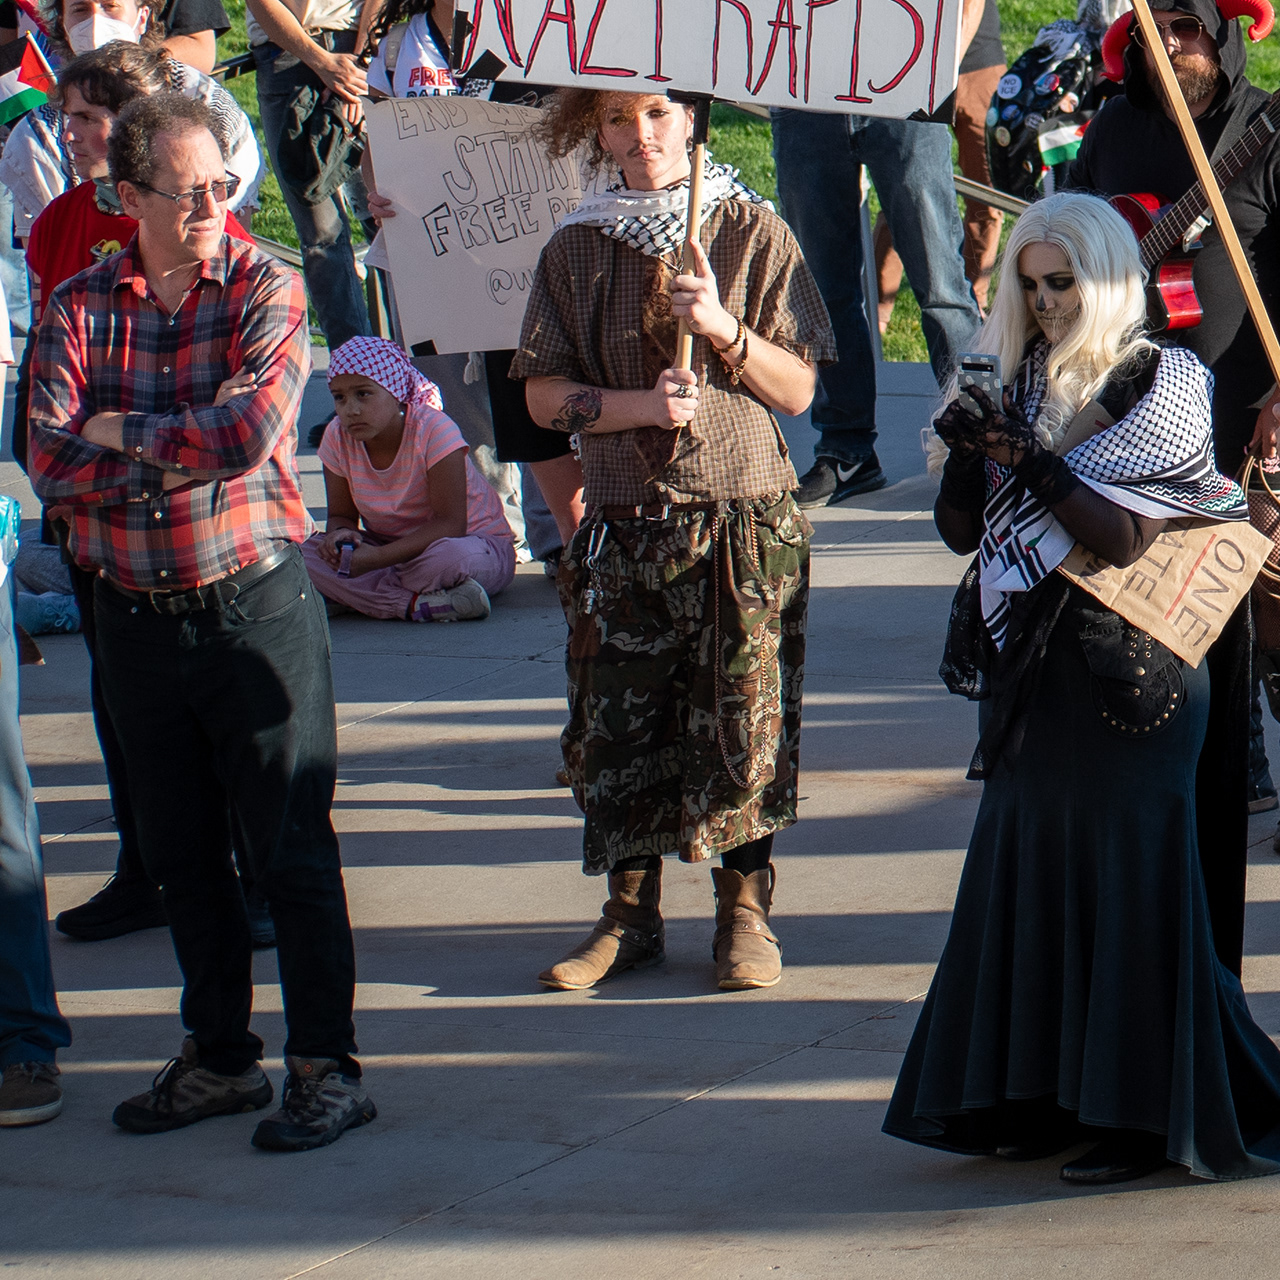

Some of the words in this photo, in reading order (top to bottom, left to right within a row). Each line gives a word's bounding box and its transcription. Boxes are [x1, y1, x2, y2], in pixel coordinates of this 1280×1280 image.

[408, 66, 459, 88] FRE
[391, 98, 469, 140] END
[422, 193, 540, 257] FREE
[1172, 537, 1246, 648] ONE
